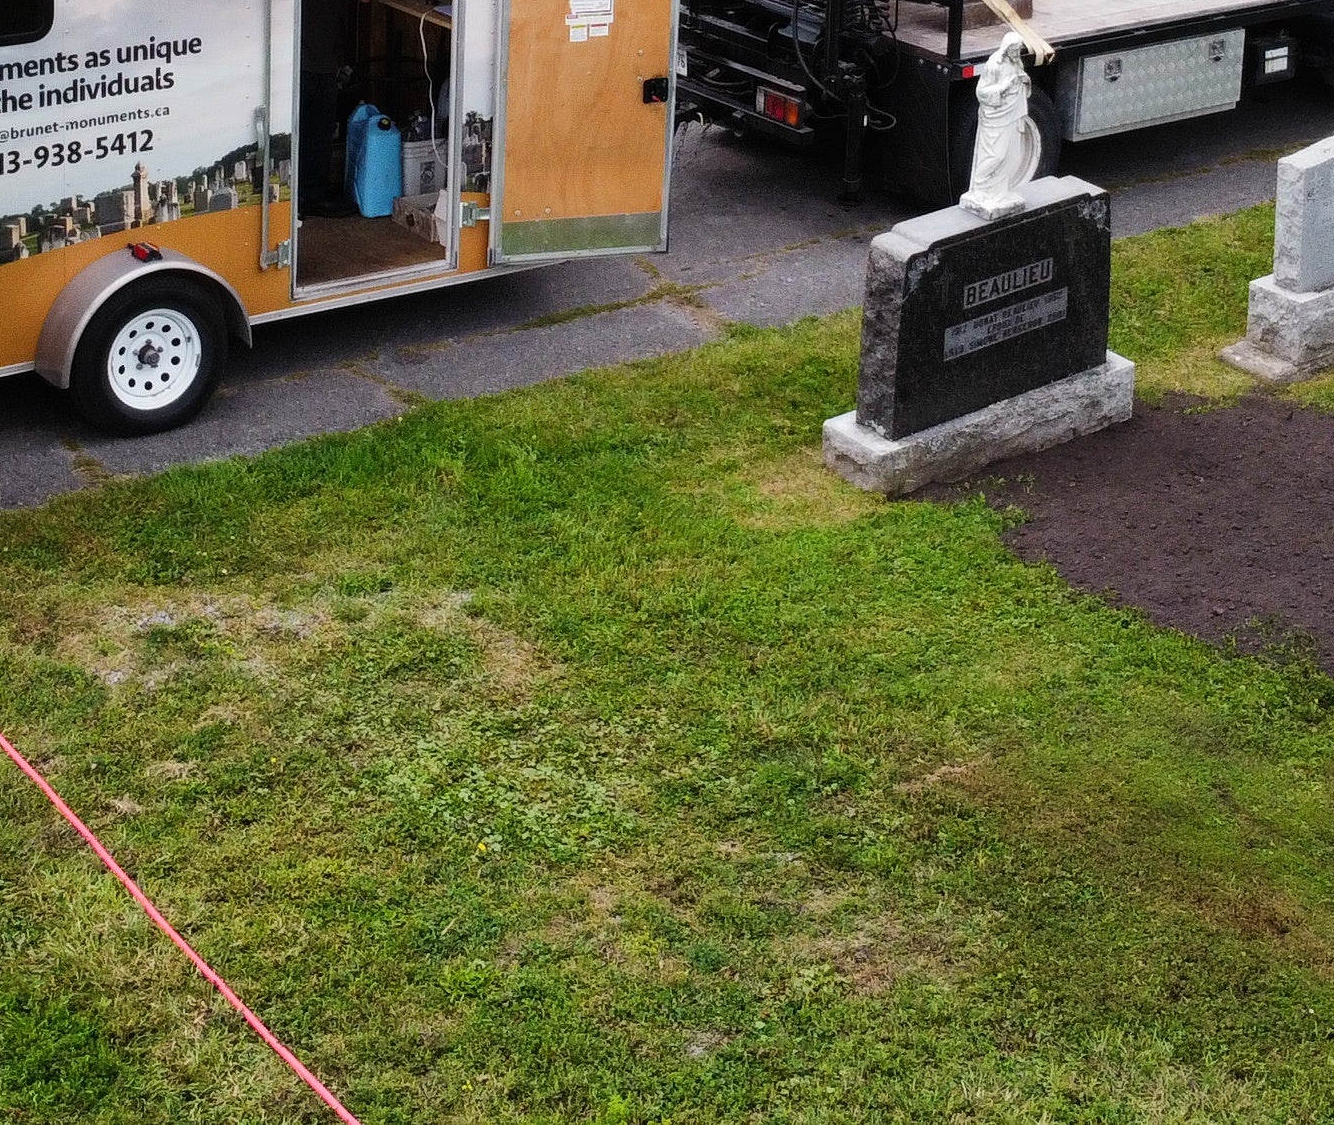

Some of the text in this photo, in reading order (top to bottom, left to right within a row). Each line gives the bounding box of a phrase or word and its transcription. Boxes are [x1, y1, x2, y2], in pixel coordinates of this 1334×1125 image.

[85, 49, 111, 69] as
[117, 36, 202, 63] unique
[39, 67, 175, 108] individuals
[967, 260, 1052, 305] BEAULIEU
